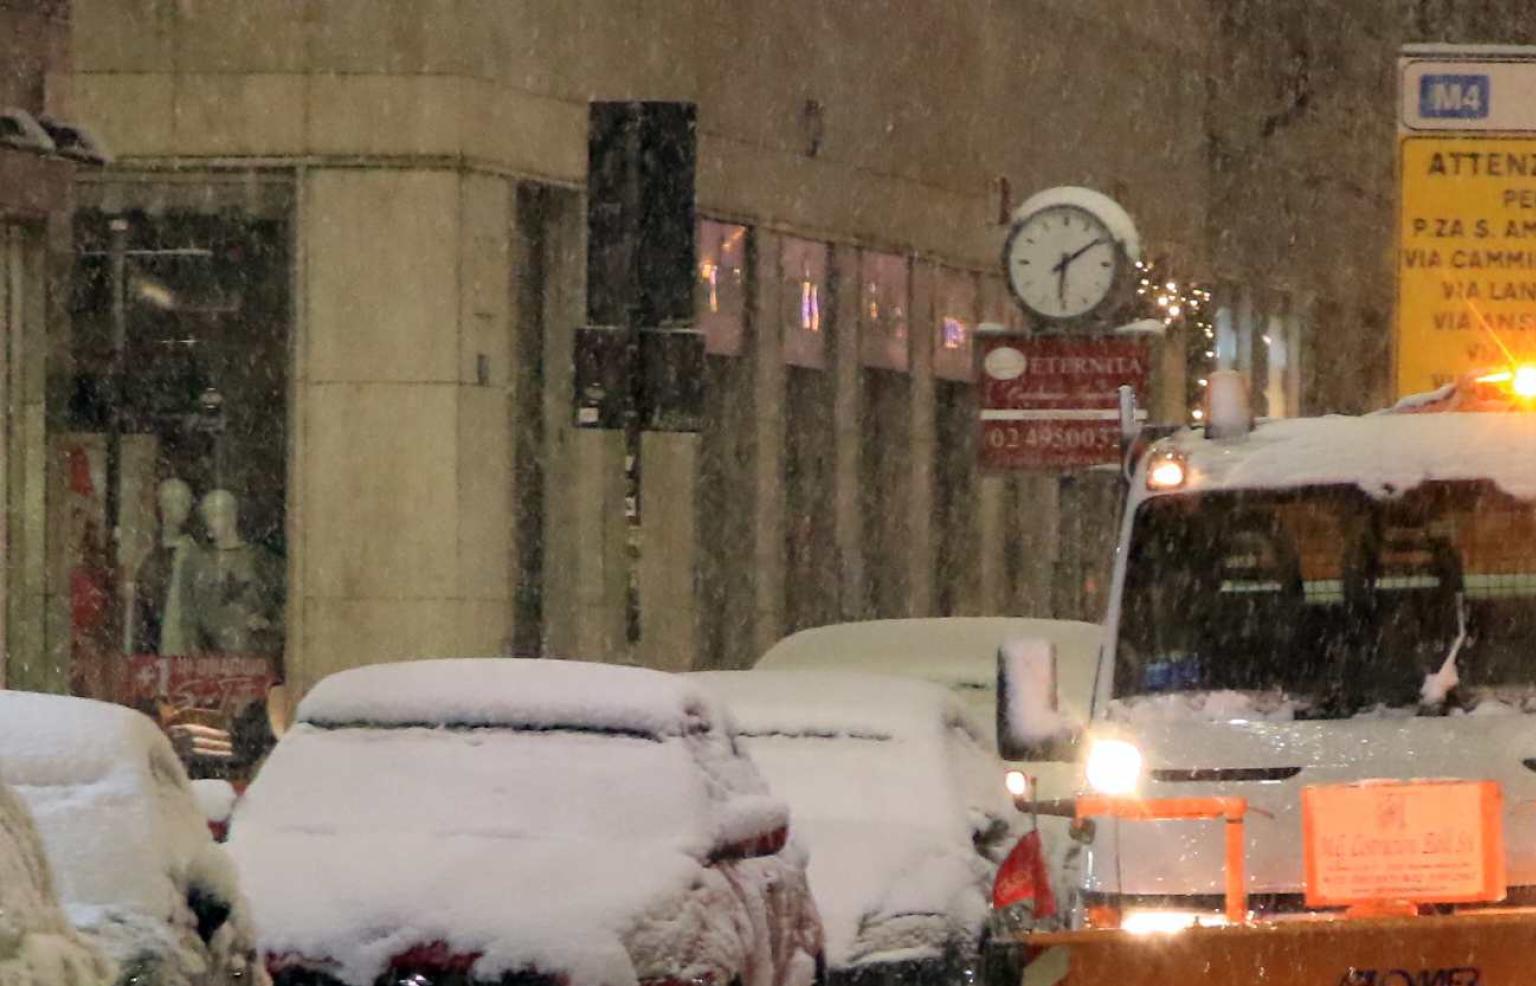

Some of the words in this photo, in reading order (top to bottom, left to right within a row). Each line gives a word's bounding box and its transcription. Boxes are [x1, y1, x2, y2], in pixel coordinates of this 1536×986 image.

[1433, 84, 1482, 112] M4
[1404, 248, 1442, 268] VIA
[1442, 281, 1480, 300] VIA
[1433, 313, 1471, 331] VIA
